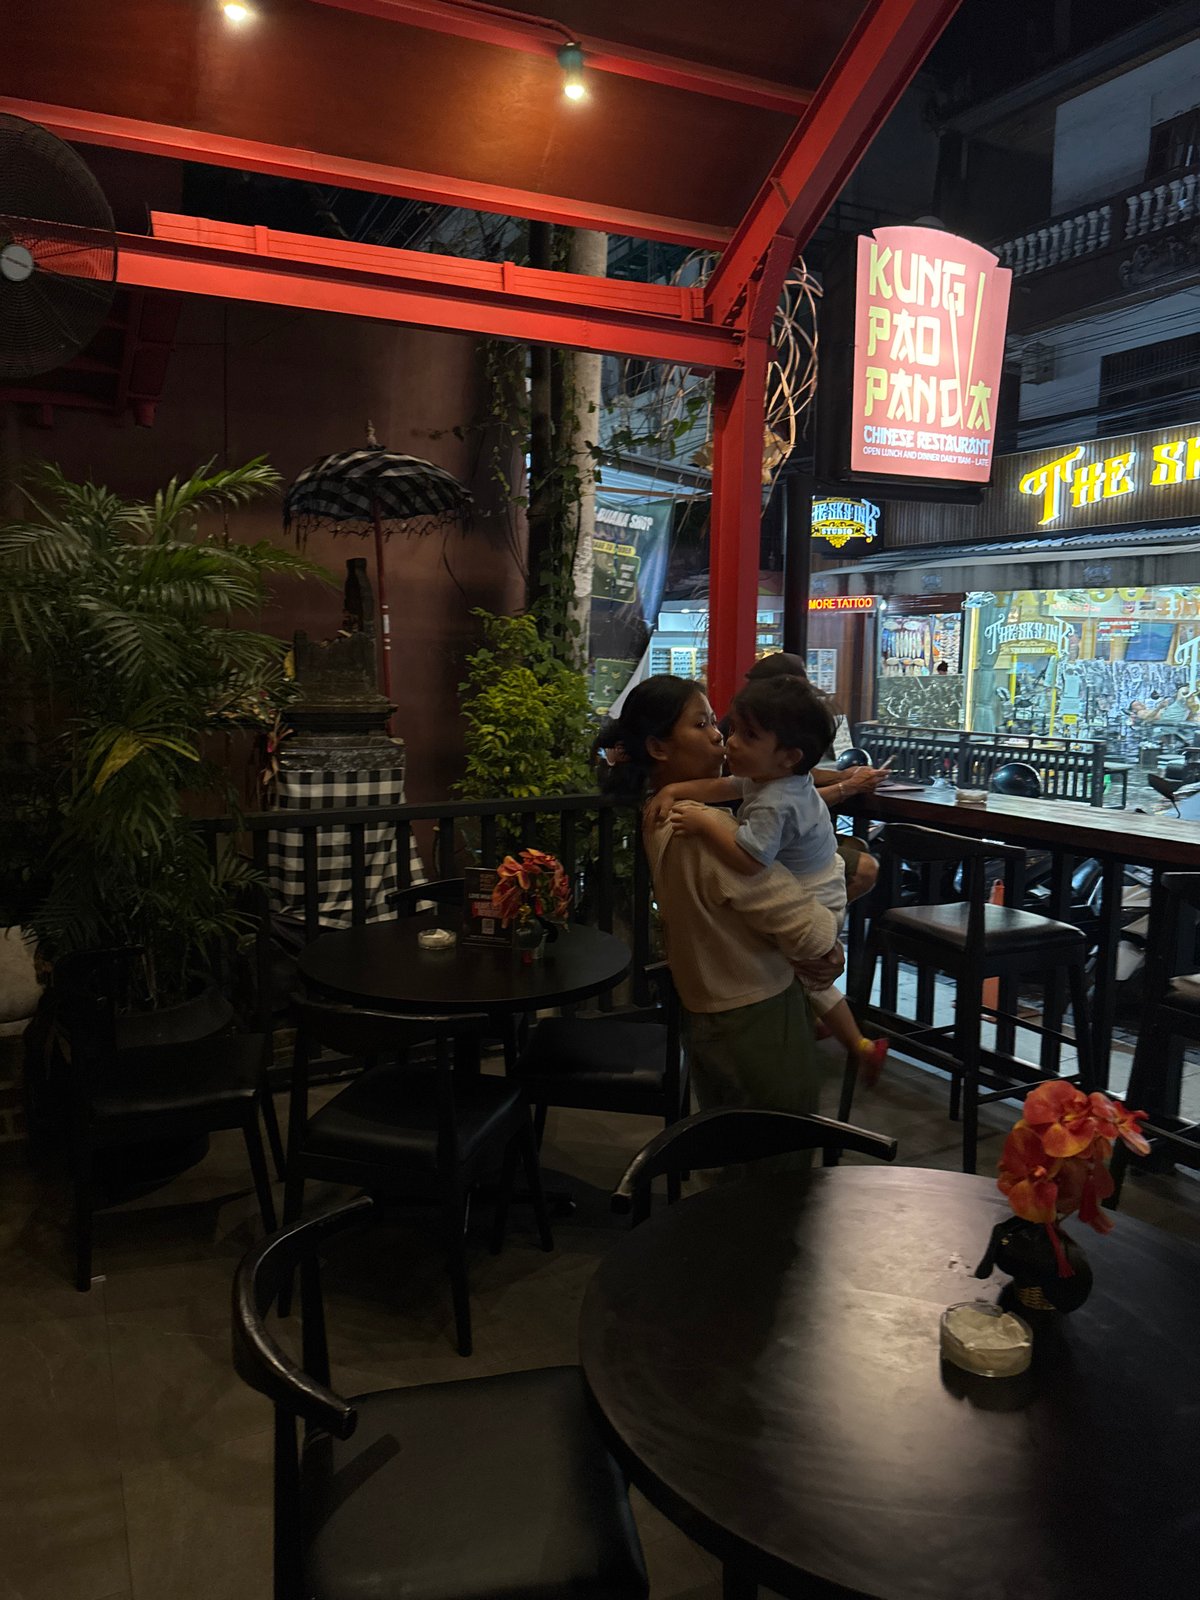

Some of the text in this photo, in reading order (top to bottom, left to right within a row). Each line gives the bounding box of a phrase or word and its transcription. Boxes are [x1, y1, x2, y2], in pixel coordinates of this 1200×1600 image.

[869, 244, 967, 317] KUNG
[867, 305, 941, 367] PAO
[864, 366, 992, 432] PANDA
[862, 446, 881, 456] OPEN
[881, 448, 903, 459] LUNCH
[903, 450, 917, 460] AND
[917, 452, 940, 462] DINNER
[975, 458, 989, 467] LATE
[863, 425, 990, 456] CHINESE RESTAURANT
[808, 598, 873, 609] MORE TATTOO
